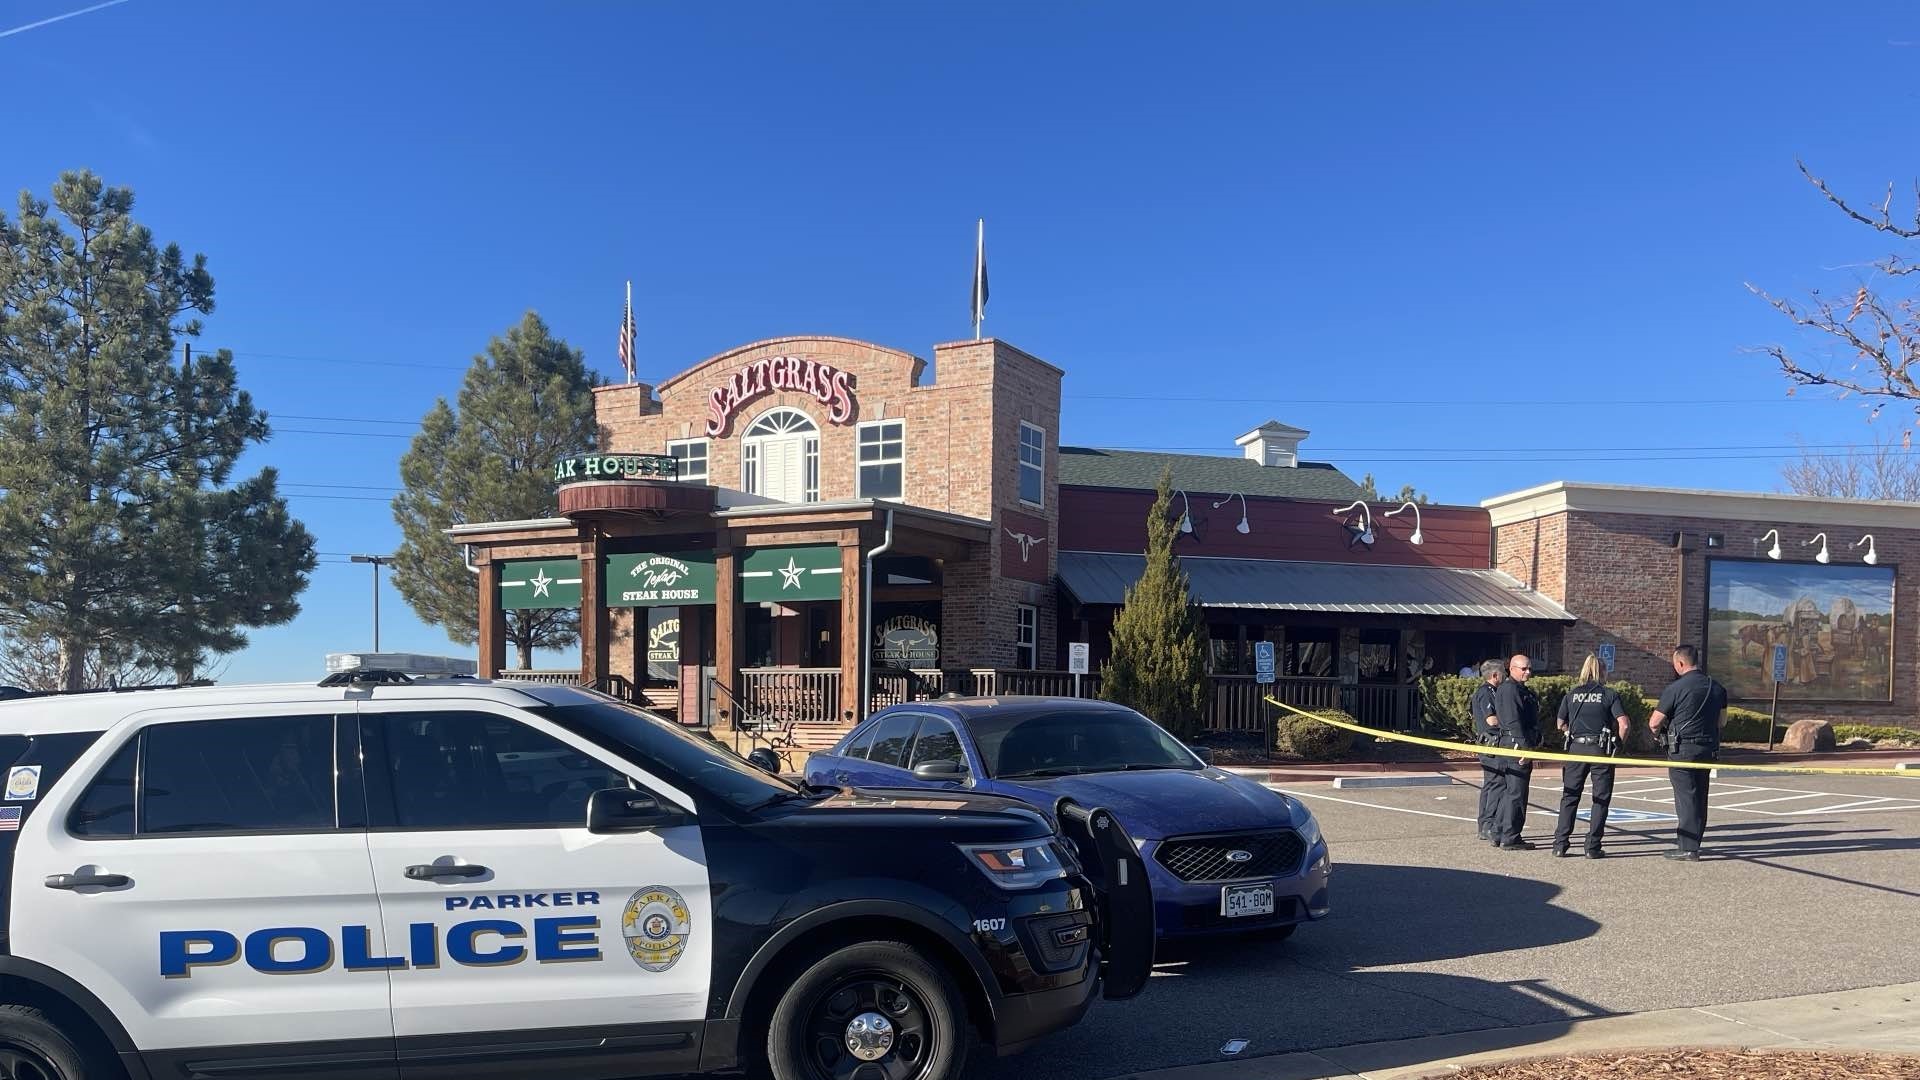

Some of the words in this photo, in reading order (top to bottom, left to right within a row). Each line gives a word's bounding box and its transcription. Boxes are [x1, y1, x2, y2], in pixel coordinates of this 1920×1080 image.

[705, 356, 852, 436] SALTGRASS
[554, 459, 577, 480] AK
[584, 457, 674, 476] HOUSE
[630, 560, 649, 578] THE
[649, 556, 690, 576] ORIGINAL
[643, 568, 682, 589] Texas
[622, 590, 659, 601] STEAK
[661, 589, 699, 600] HOUSE
[873, 615, 938, 647] SALTGRASS
[650, 652, 674, 660] STEAK
[909, 649, 936, 660] HOUSE
[1572, 692, 1603, 703] POLICE
[445, 890, 601, 911] PARKER
[973, 918, 1006, 932] 1607
[159, 915, 604, 979] POLICE
